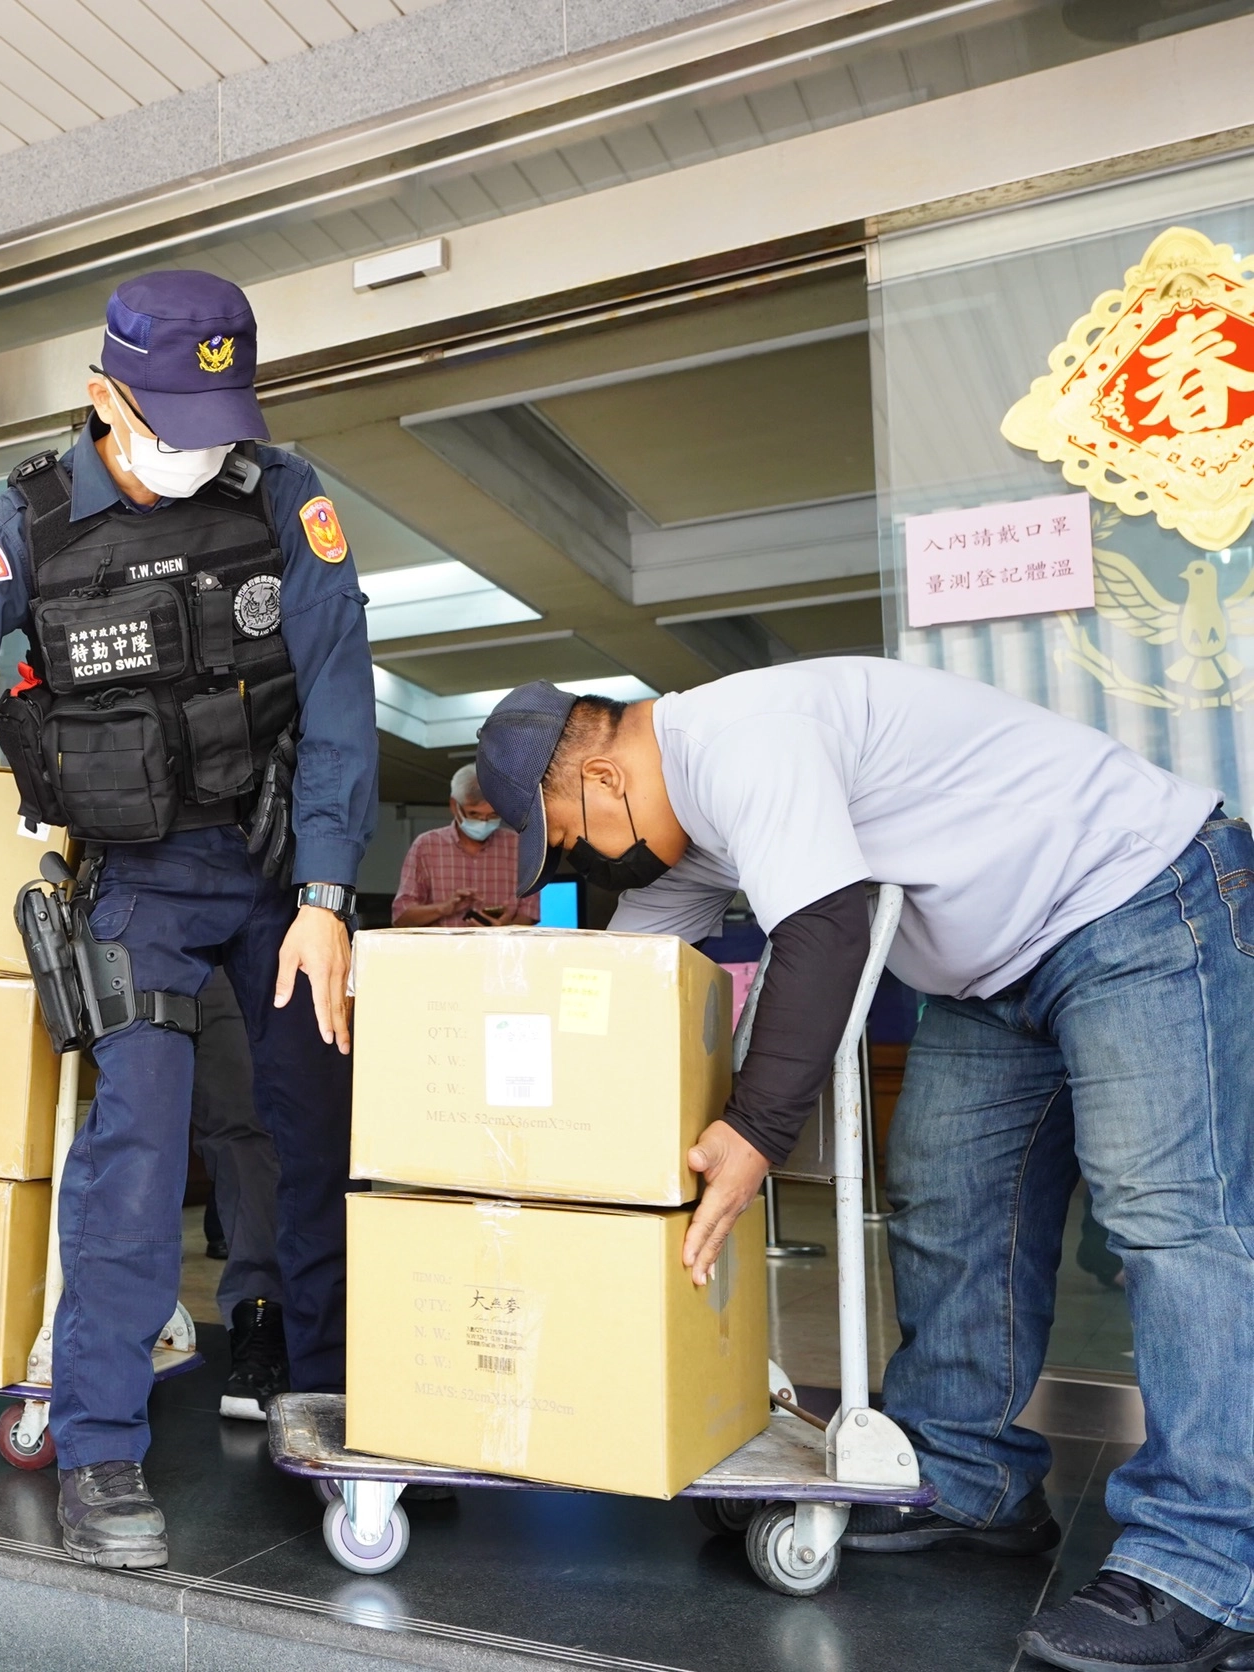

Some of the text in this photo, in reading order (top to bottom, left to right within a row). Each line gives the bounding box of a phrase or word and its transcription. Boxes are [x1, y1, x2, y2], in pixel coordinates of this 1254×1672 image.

[1135, 312, 1254, 434] 春
[923, 515, 1071, 553] 入內請戴口罩
[129, 558, 183, 579] T.W. CHEN
[926, 559, 1075, 595] 量測登記體溫
[69, 620, 148, 643] 高雄市政府警察局
[71, 632, 151, 663] 特勤中隊
[74, 654, 153, 678] KCPD SWAT
